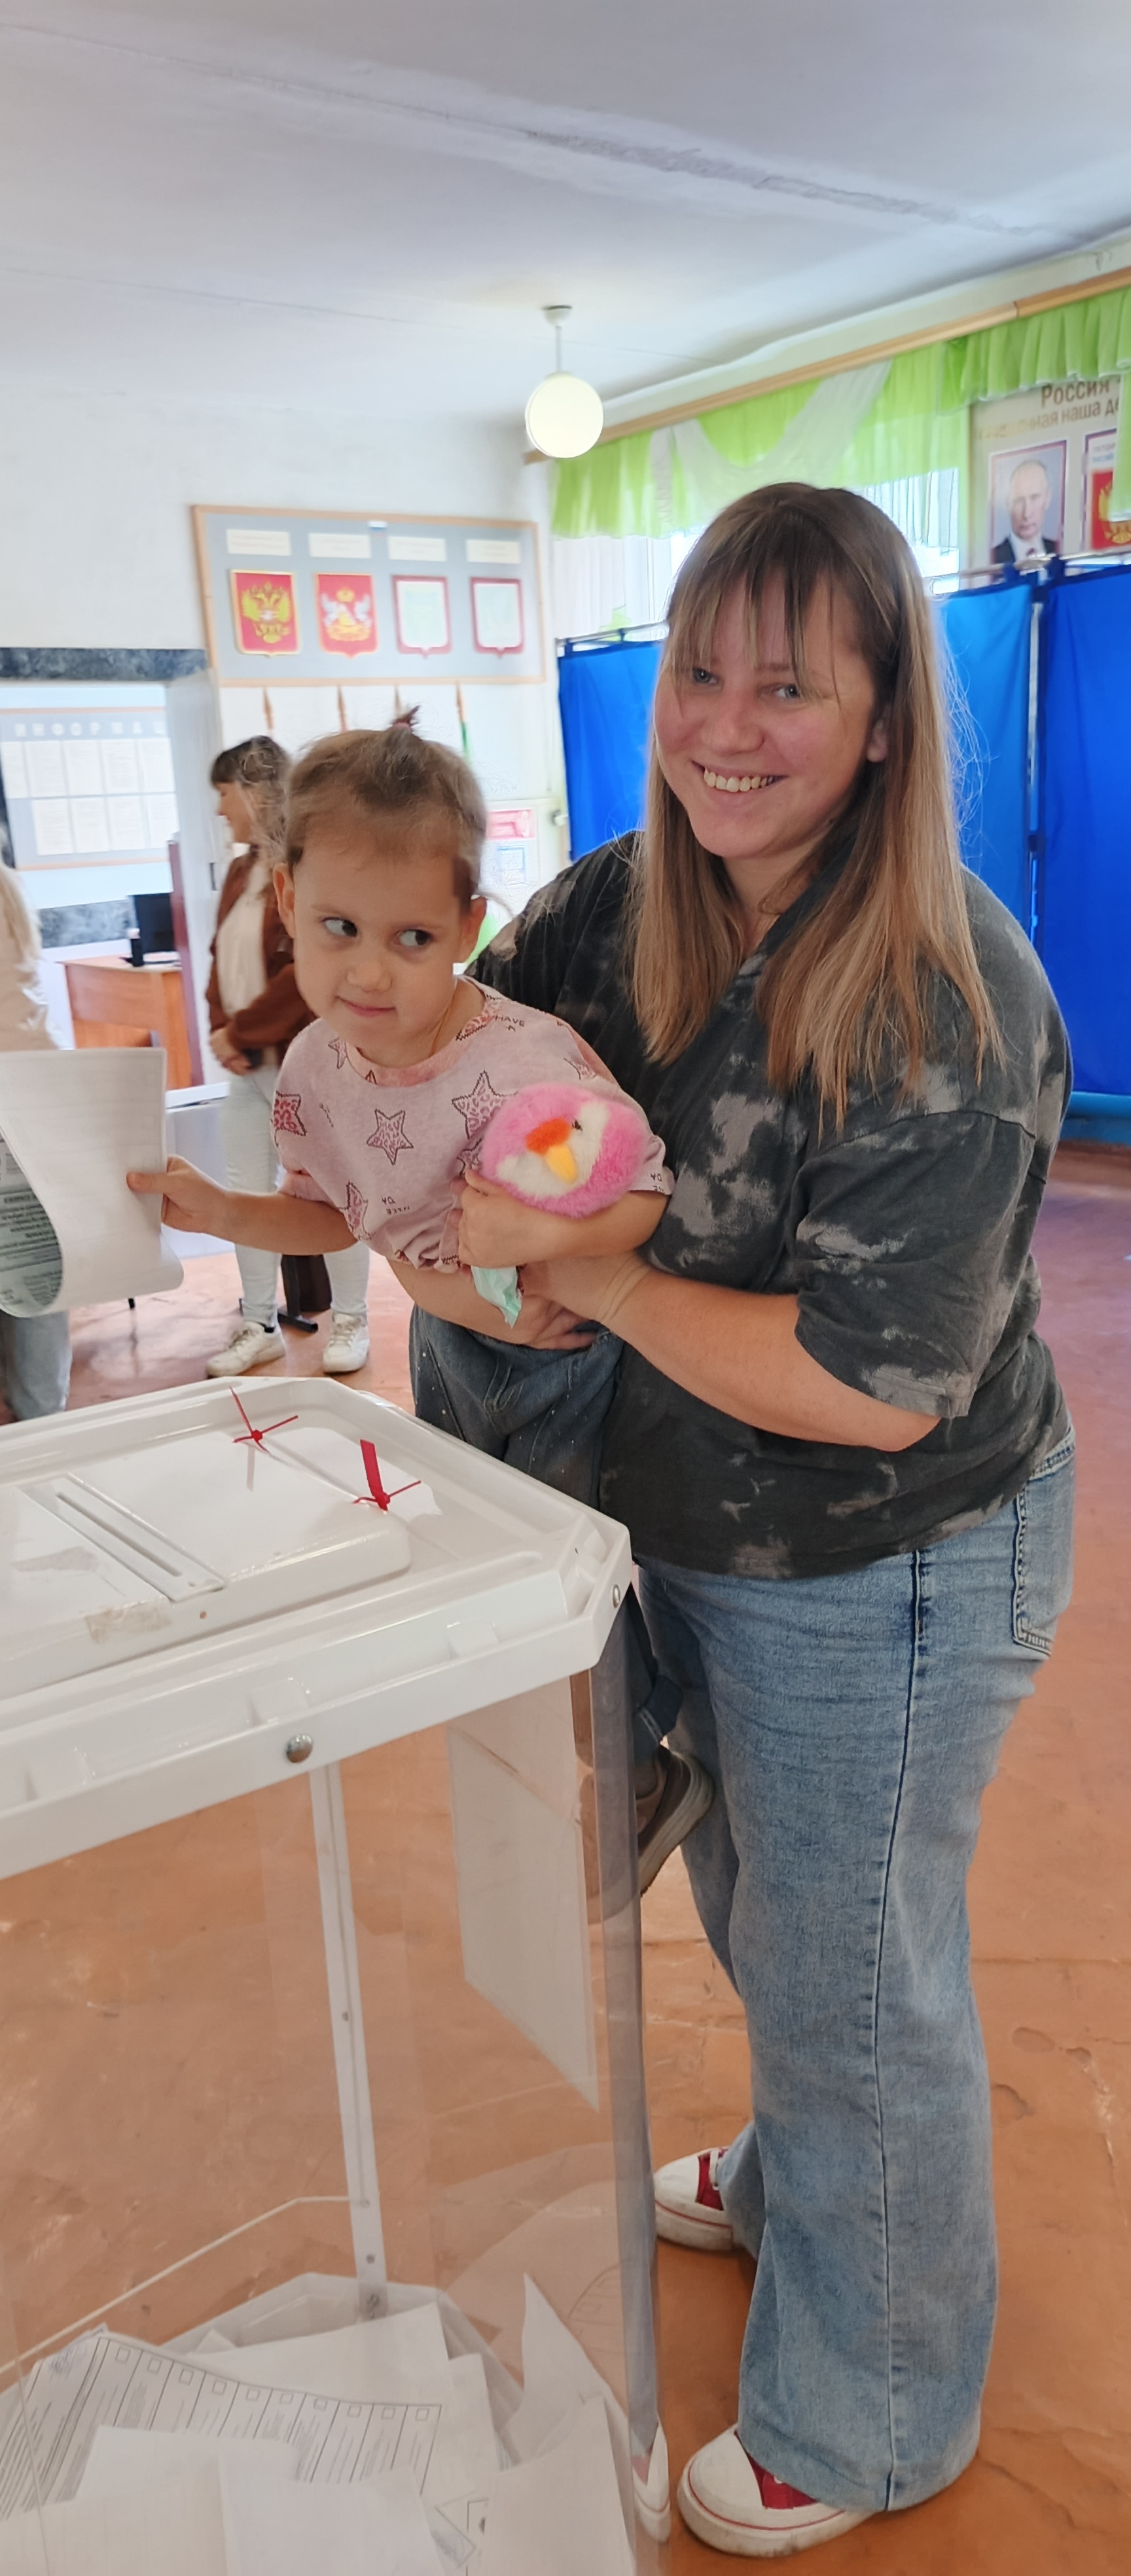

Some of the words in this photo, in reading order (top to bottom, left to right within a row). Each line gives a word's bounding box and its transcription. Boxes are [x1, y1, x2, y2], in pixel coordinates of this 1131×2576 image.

[1041, 380, 1109, 408] Россия
[1061, 401, 1101, 424] наша
[495, 1015, 526, 1027] HAVE
